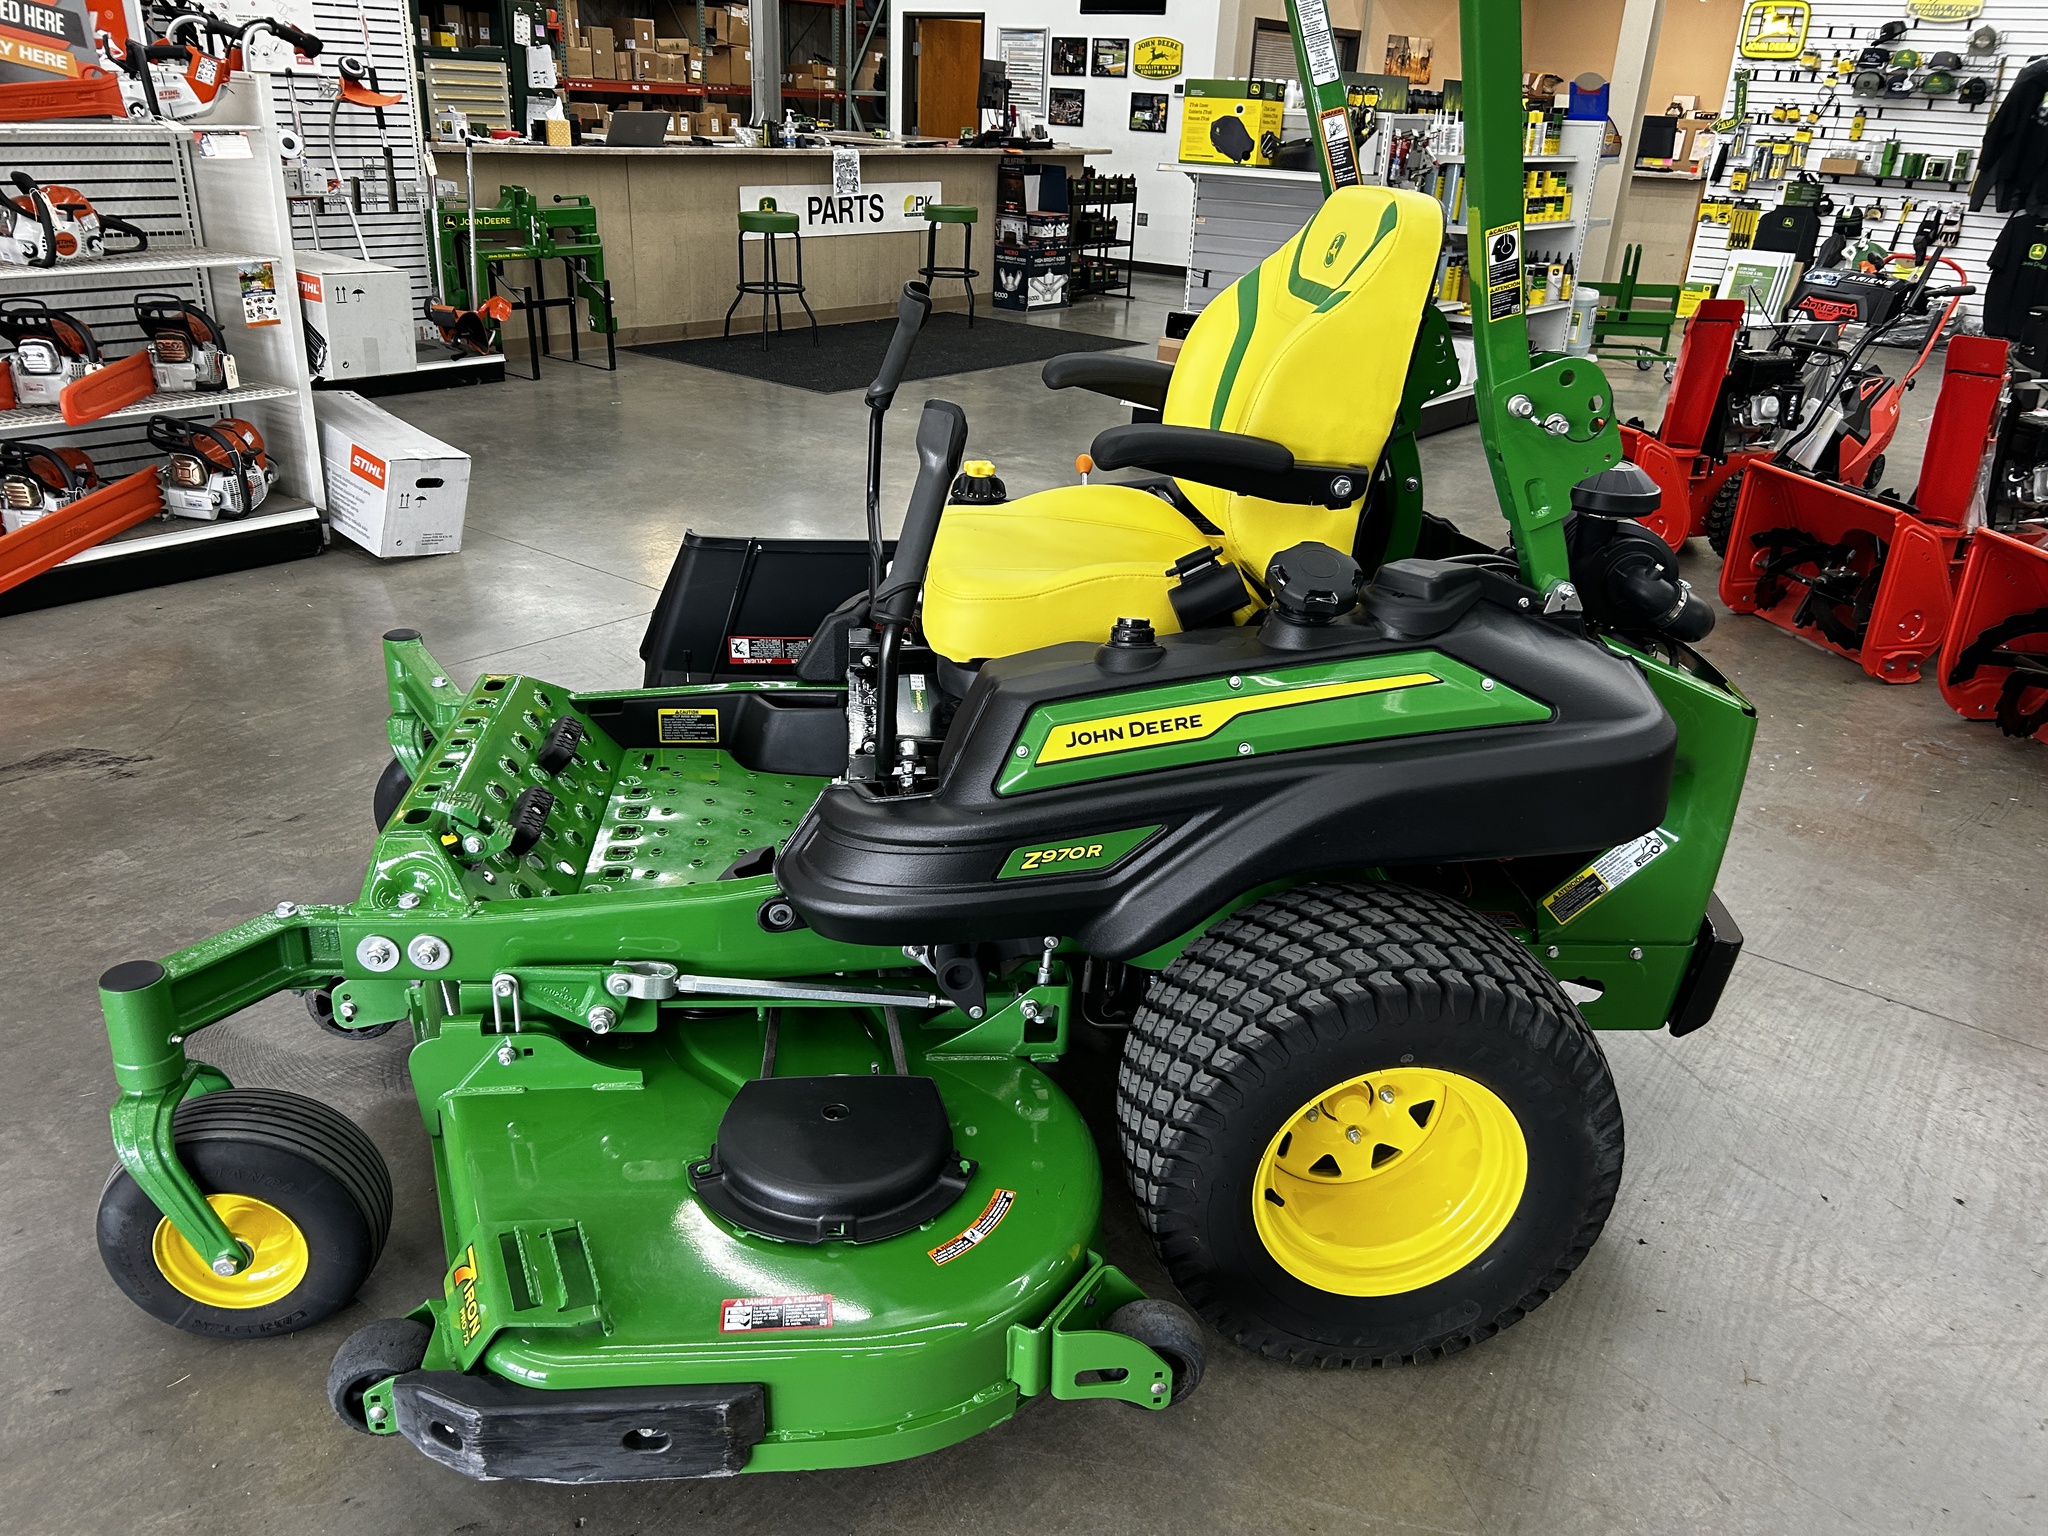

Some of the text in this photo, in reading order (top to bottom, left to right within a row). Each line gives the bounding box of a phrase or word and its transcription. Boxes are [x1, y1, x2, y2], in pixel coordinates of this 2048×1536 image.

[24, 4, 65, 35] HERE
[1137, 39, 1179, 50] JOHN DEERE
[19, 45, 68, 69] HERE
[460, 216, 511, 226] JON DEERE
[807, 193, 933, 226] PARTS PK
[1493, 223, 1518, 234] CAUTION
[1801, 300, 1857, 317] COMPACT
[352, 454, 384, 480] STIHL
[1065, 714, 1203, 748] JOHN DEERE
[1020, 844, 1104, 871] Z970R
[744, 1298, 773, 1306] DANGER
